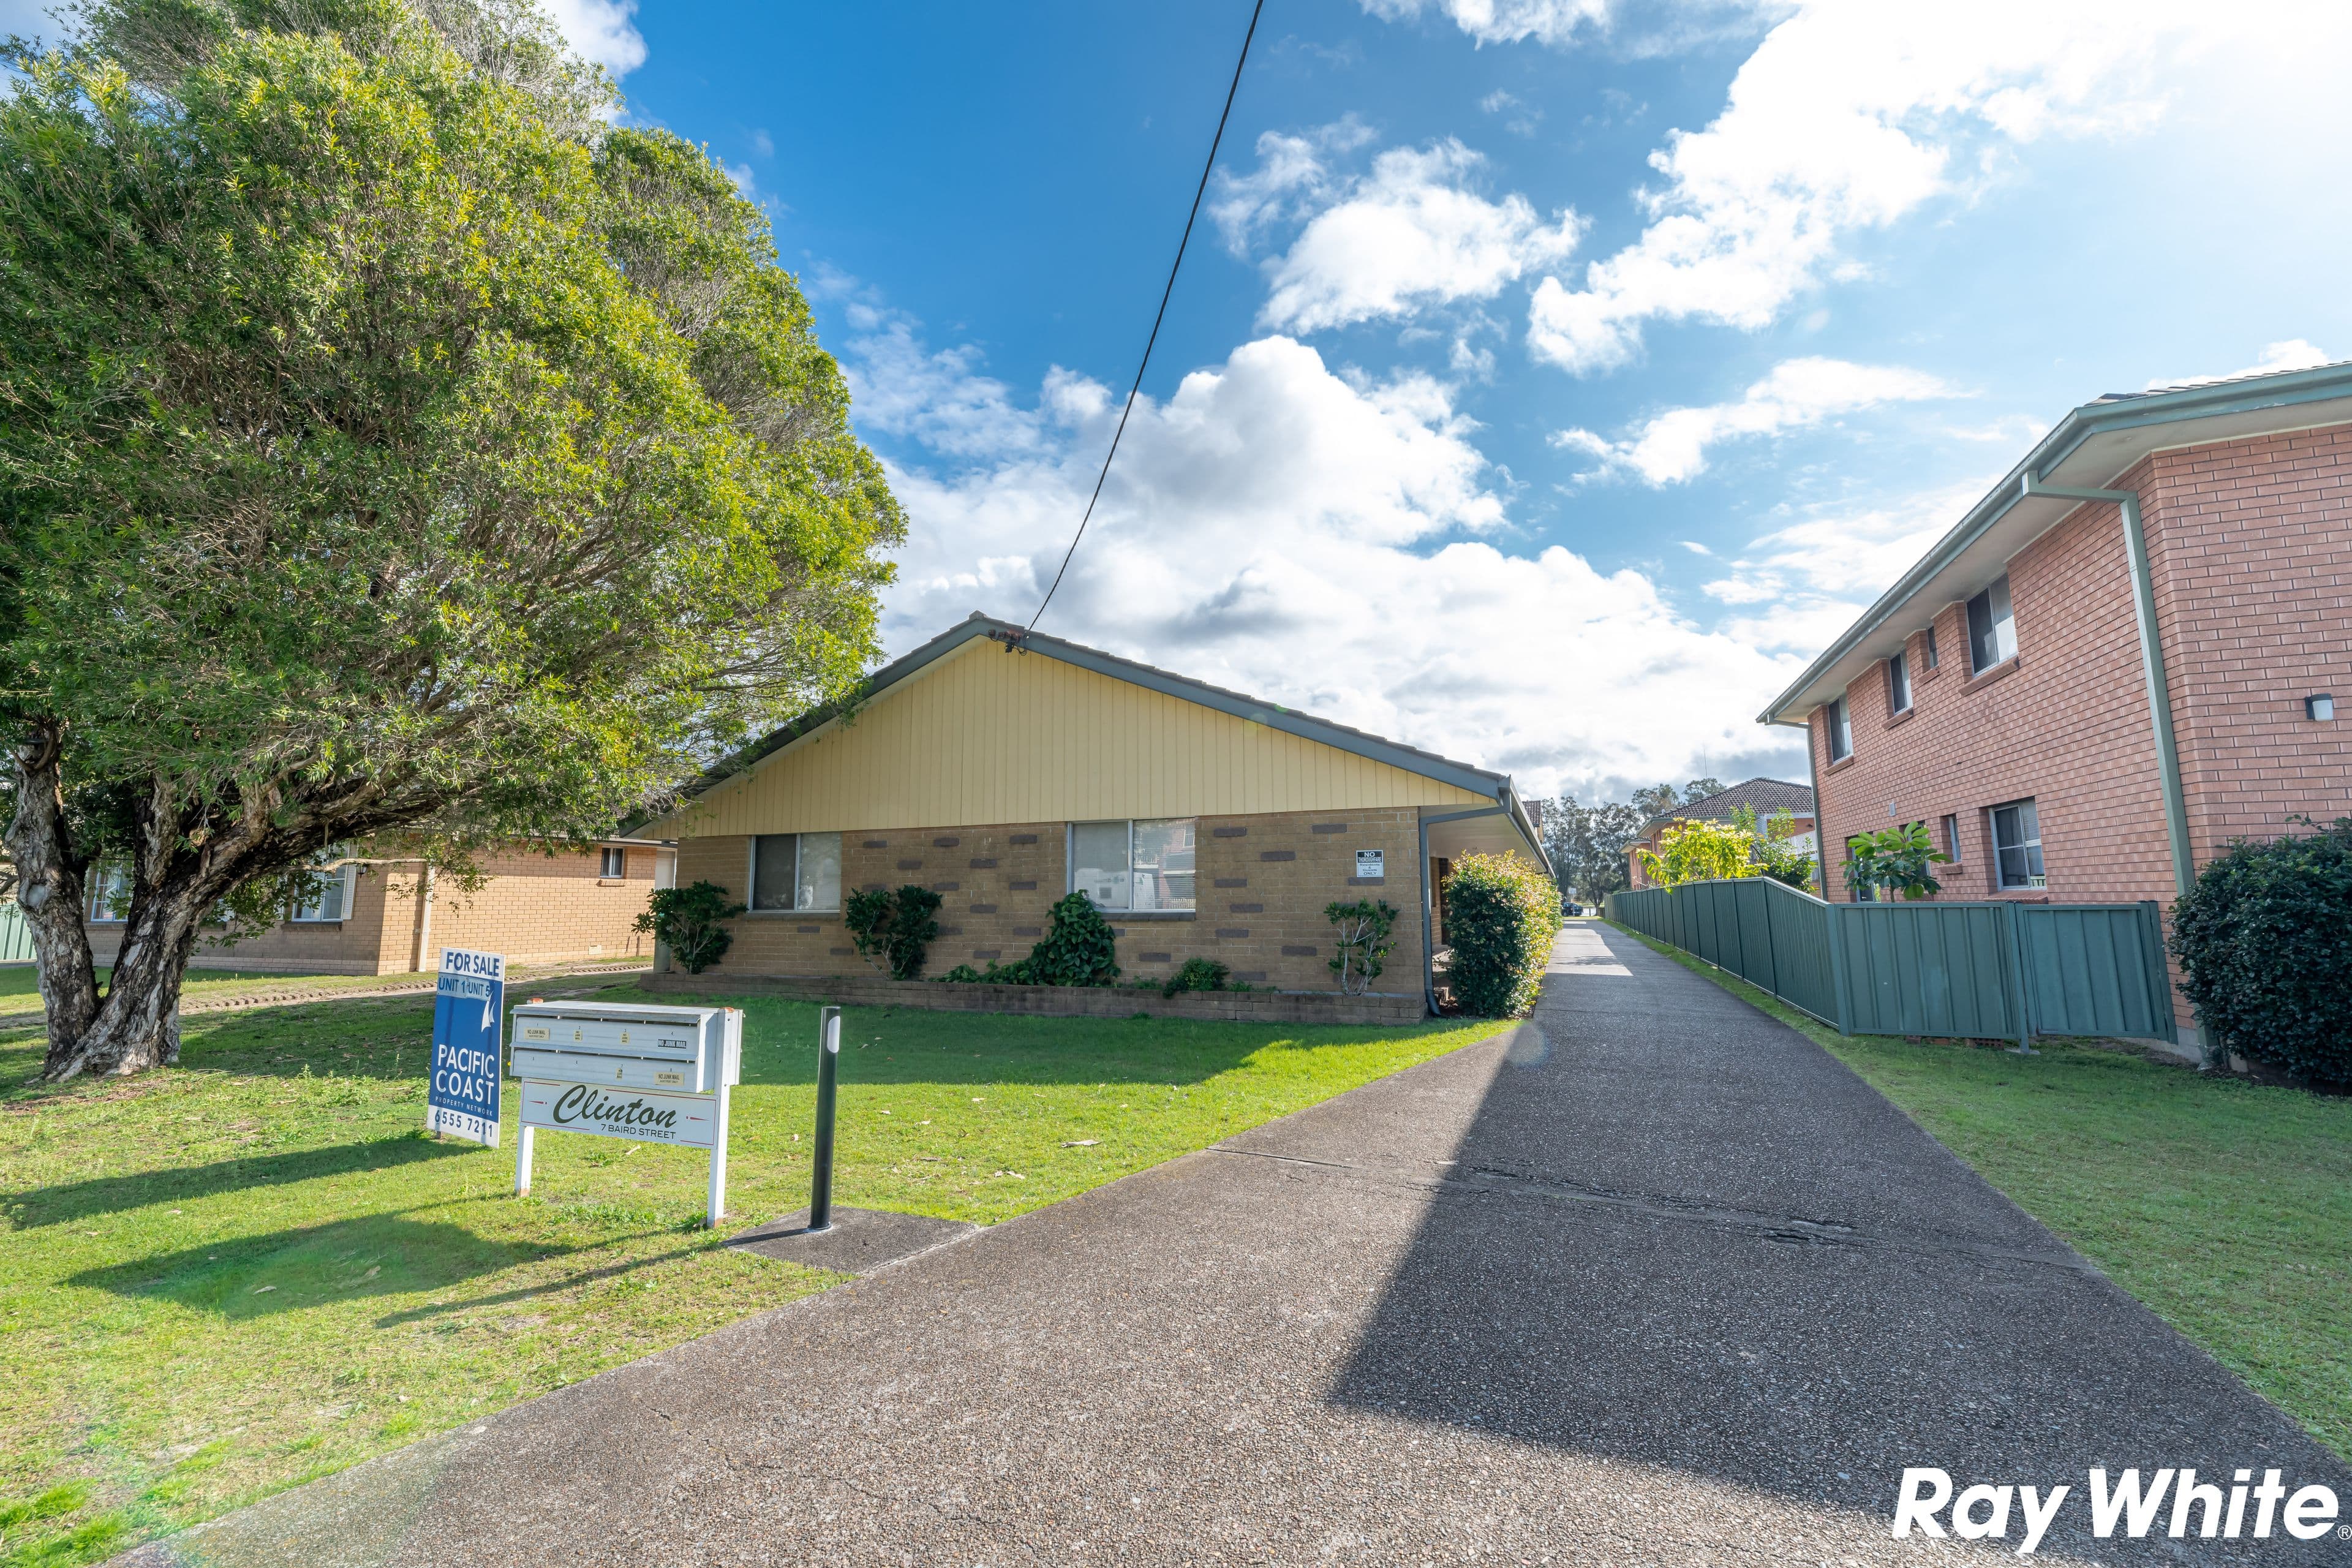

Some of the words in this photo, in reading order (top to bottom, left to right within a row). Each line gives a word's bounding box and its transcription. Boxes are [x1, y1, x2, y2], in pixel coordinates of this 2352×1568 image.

[446, 952, 470, 972] FOR
[473, 955, 500, 977] SALE
[439, 978, 459, 992] UNIT
[461, 981, 466, 993] 1
[469, 982, 484, 996] UNIT
[486, 985, 491, 997] 5
[438, 1044, 494, 1078] PACIFIC
[436, 1070, 494, 1104] COAST
[435, 1096, 464, 1108] PROPERTY
[467, 1104, 492, 1116] NETWORK
[553, 1085, 676, 1128] Clinton
[435, 1110, 462, 1128] 6555
[467, 1118, 492, 1137] 7211
[608, 1125, 636, 1134] BAIRD
[639, 1129, 676, 1139] STREET
